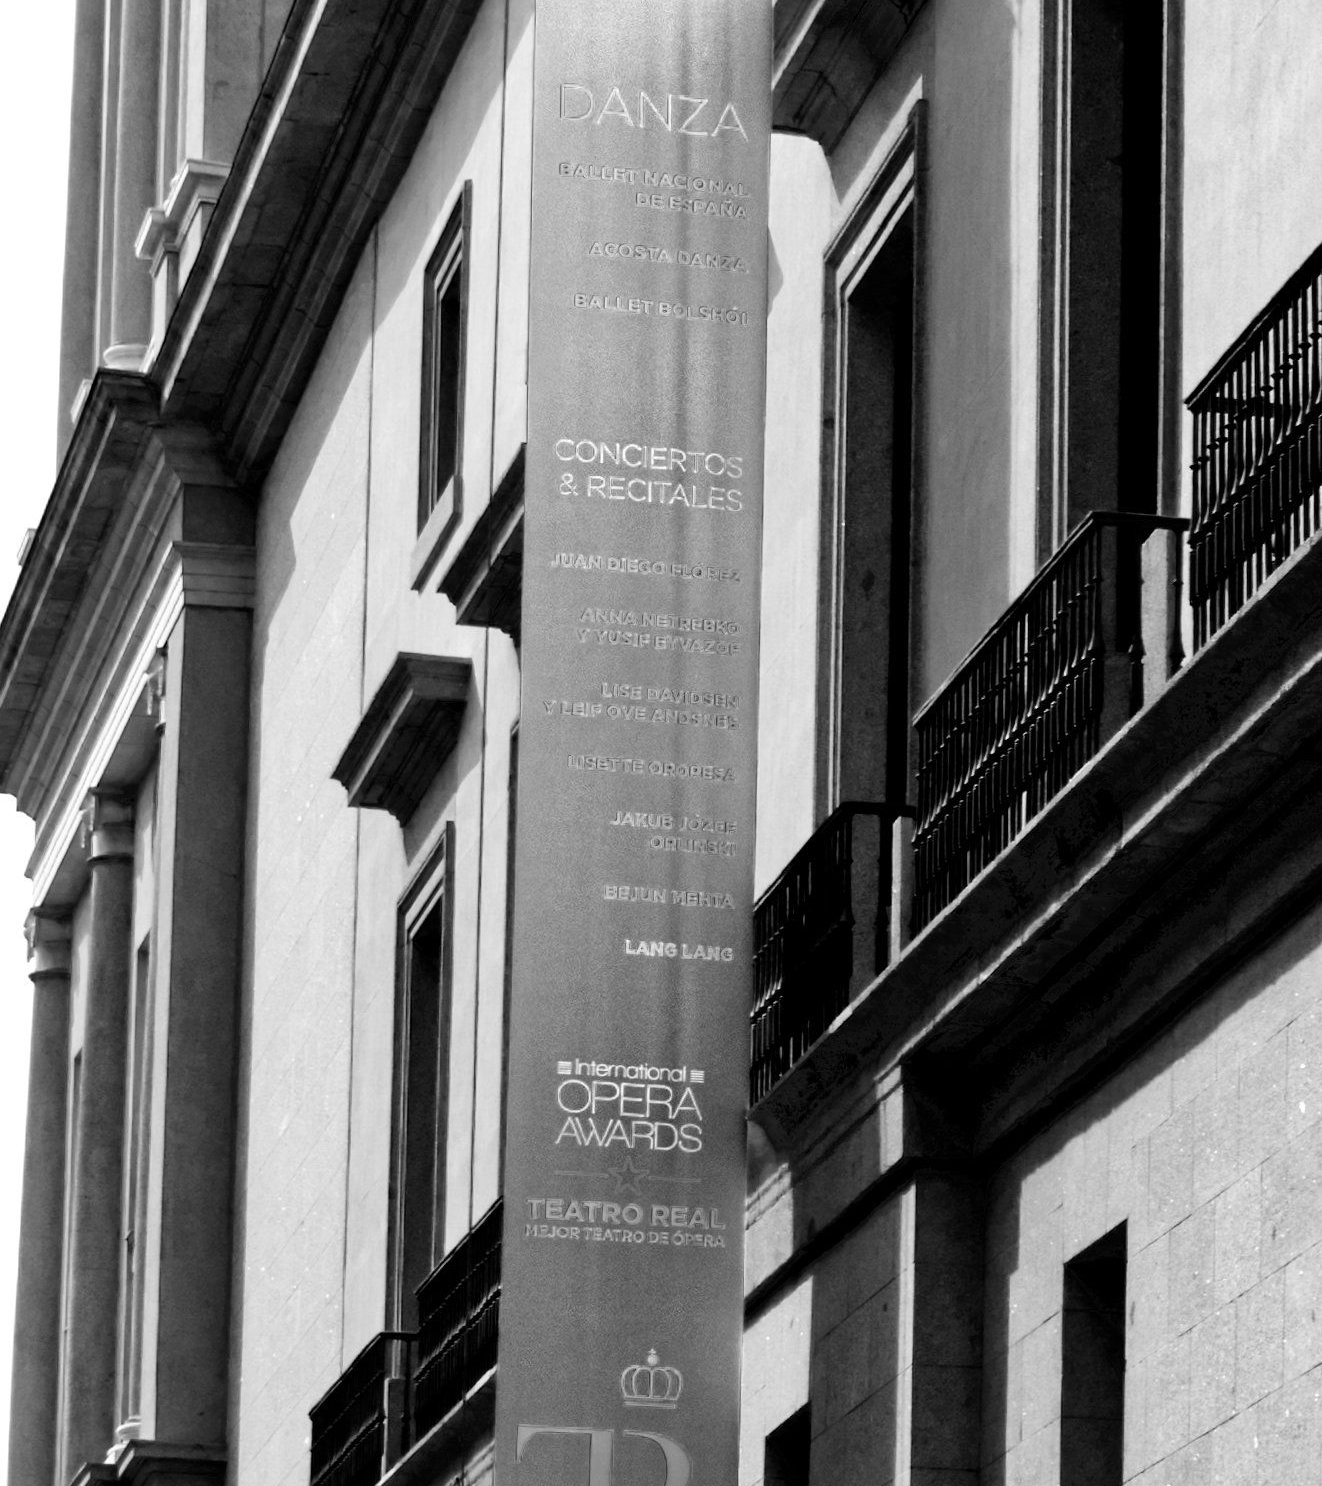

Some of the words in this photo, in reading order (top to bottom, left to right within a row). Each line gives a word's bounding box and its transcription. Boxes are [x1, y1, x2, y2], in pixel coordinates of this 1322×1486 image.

[559, 82, 749, 144] DANZA
[559, 163, 637, 185] BALLET
[643, 171, 750, 198] NACIONAL
[636, 193, 664, 211] DE
[669, 196, 748, 220] ESPAÑA
[588, 242, 671, 264] ACOSTA
[676, 250, 749, 273] DANZA
[574, 293, 655, 315] BALLET
[555, 438, 743, 480] CONCIERTOS
[559, 472, 579, 497] &
[587, 475, 743, 512] RECITALES
[551, 553, 602, 571] JUAN
[608, 557, 667, 576] DIEGO
[669, 562, 740, 583] FLÓREZ
[580, 608, 637, 627] ANNA
[640, 613, 740, 636] NETREBKO
[577, 629, 592, 643] Y
[596, 629, 651, 650] YUSIF
[653, 634, 740, 656] EYVAZOF
[601, 683, 643, 701] LISE
[647, 688, 740, 710] DAVIDSEN
[542, 700, 557, 716] Y
[606, 704, 646, 722] OVE
[650, 709, 739, 731] ANDSNES
[567, 754, 644, 775] LISETTE
[648, 761, 736, 782] OROPESA
[610, 811, 674, 830] JAKUB
[603, 885, 667, 904] BEJUN
[671, 890, 736, 911] MEHTA
[624, 938, 679, 958] LANG
[681, 943, 735, 962] LANG
[574, 1058, 688, 1083] International
[557, 1078, 704, 1122] OPERA
[554, 1115, 703, 1153] AWARDS
[526, 1198, 645, 1226] TEATRO
[650, 1204, 727, 1230] REAL
[524, 1223, 581, 1242] MEJOR
[582, 1226, 647, 1245] TEATRO
[649, 1231, 670, 1246] DE
[672, 1229, 727, 1249] ÓPERA
